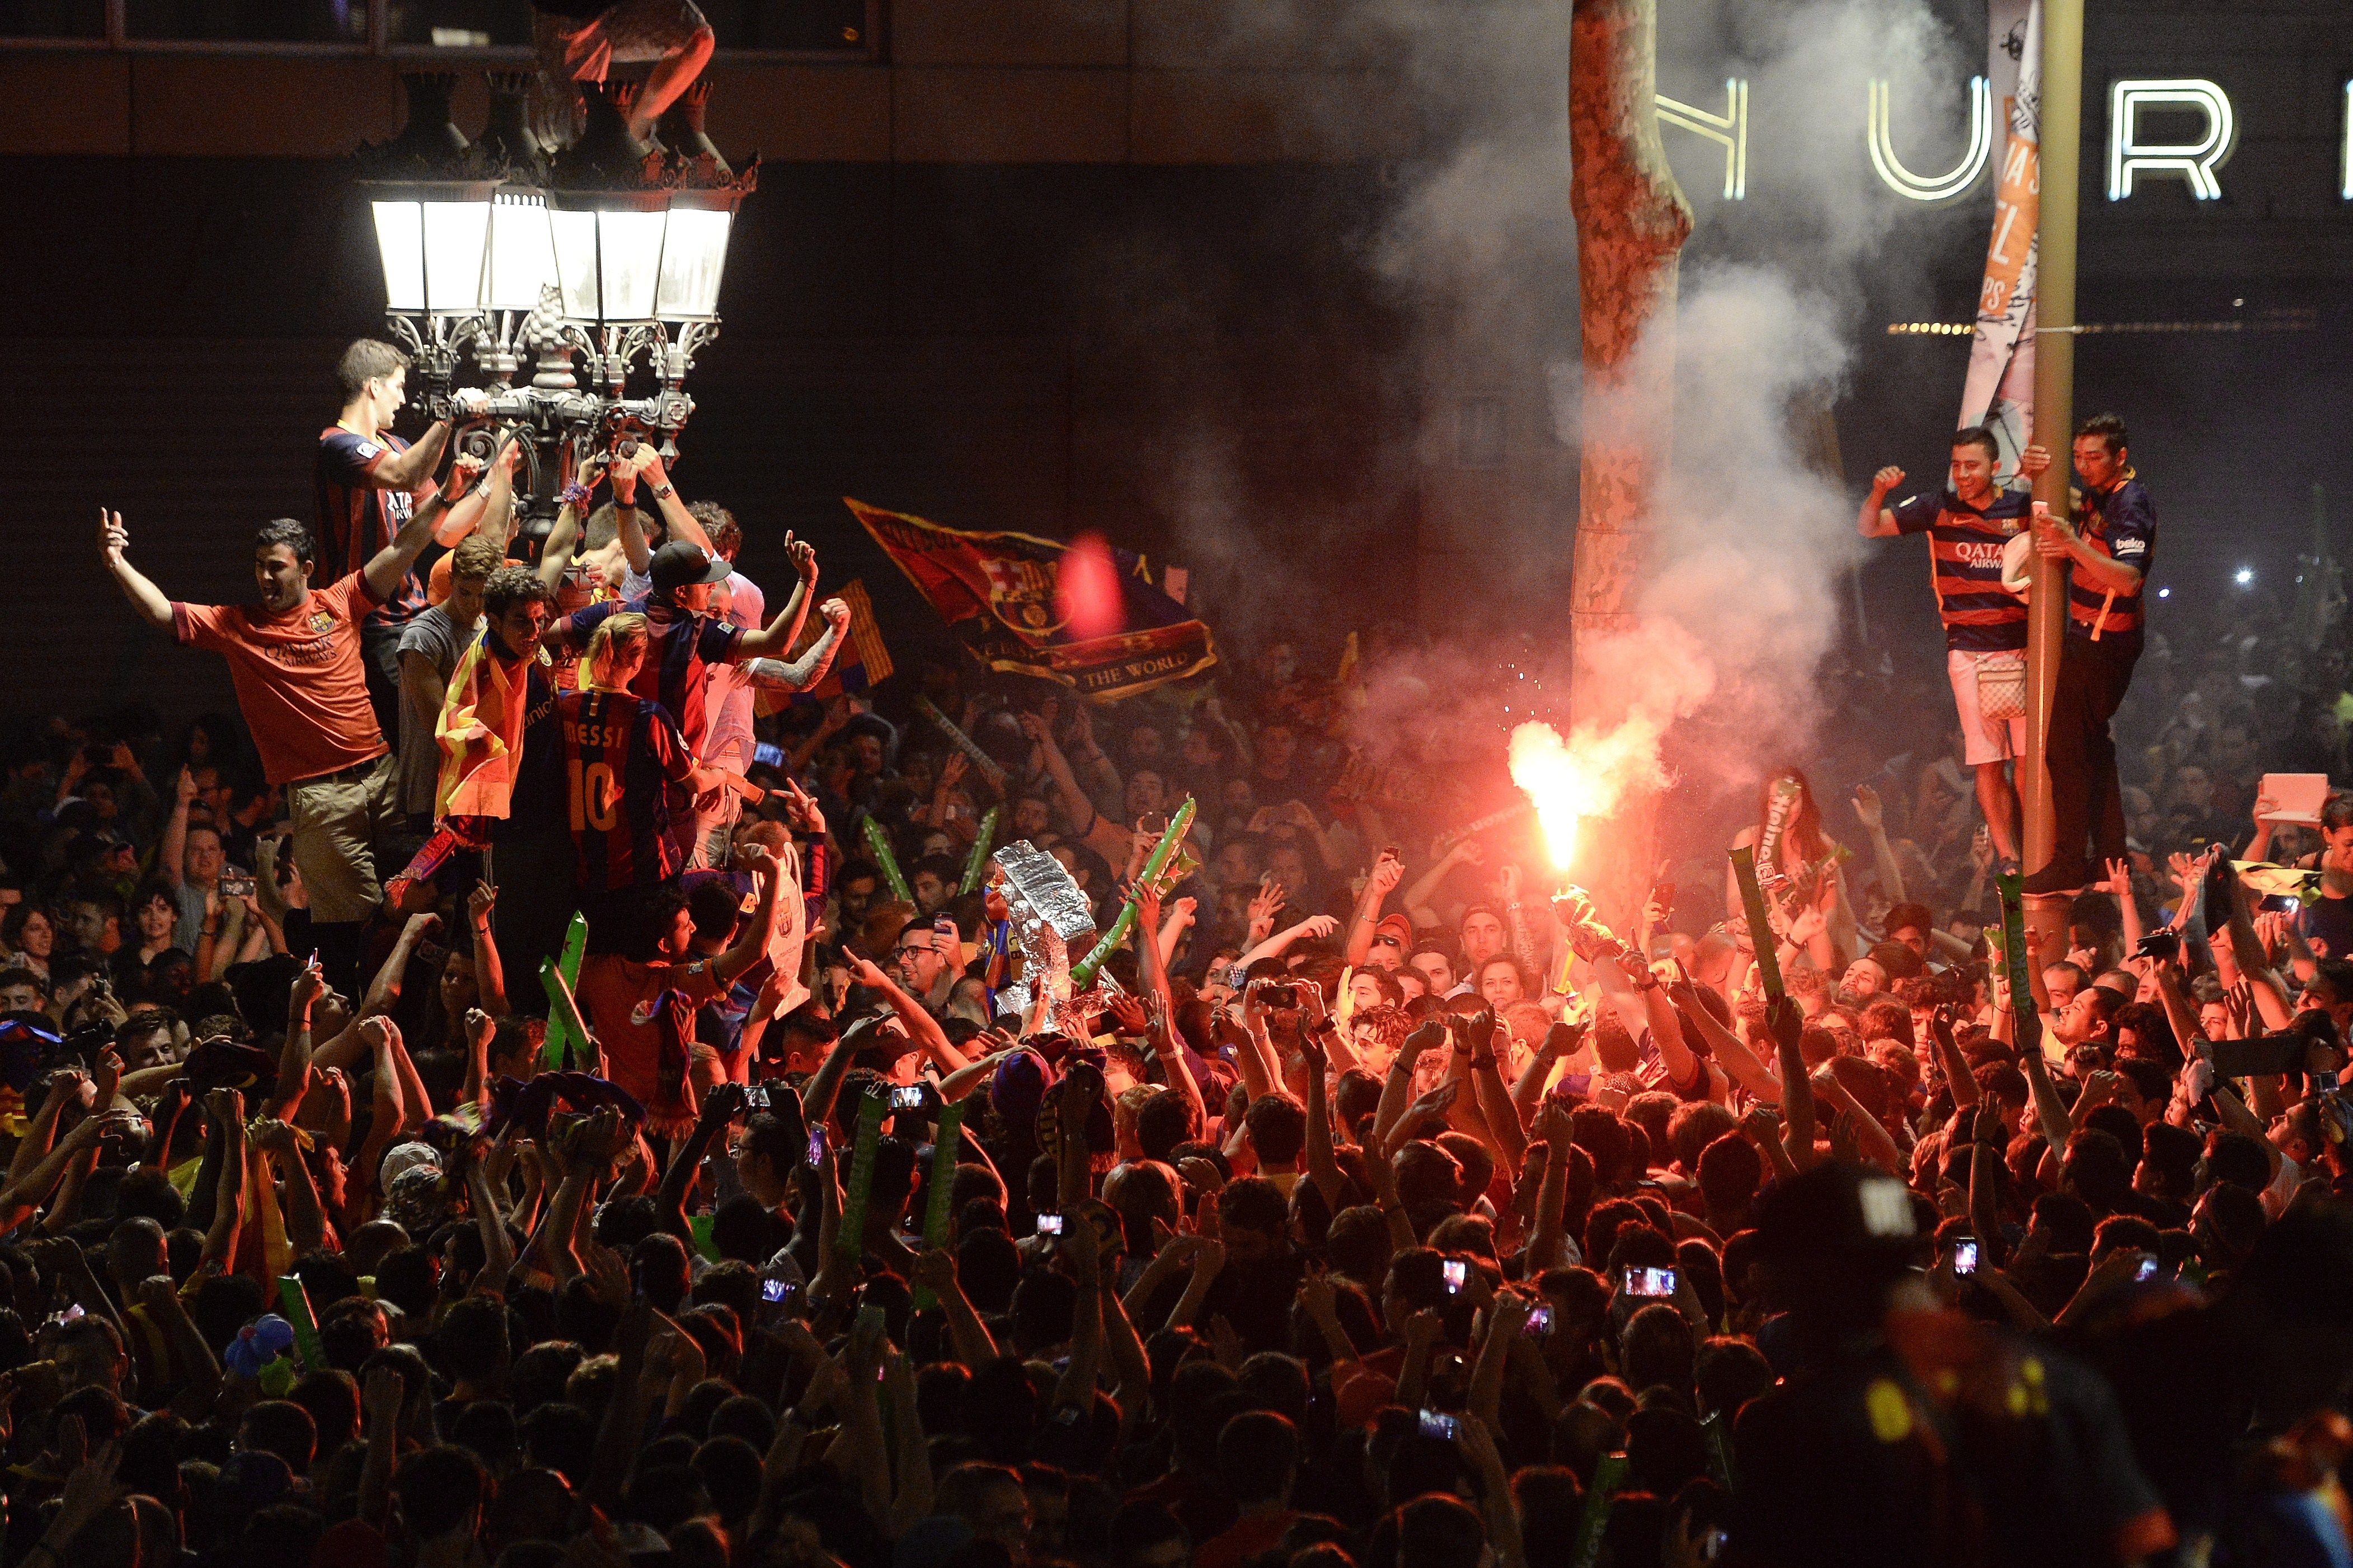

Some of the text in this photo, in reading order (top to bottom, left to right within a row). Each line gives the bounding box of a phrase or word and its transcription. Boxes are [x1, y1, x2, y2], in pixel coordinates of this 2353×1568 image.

[1955, 541, 2005, 562] QATA
[2115, 538, 2146, 551] beko
[265, 634, 334, 661] QATAR
[1083, 651, 1190, 689] THE WORLD
[562, 721, 624, 749] MESSI
[567, 759, 617, 832] 10
